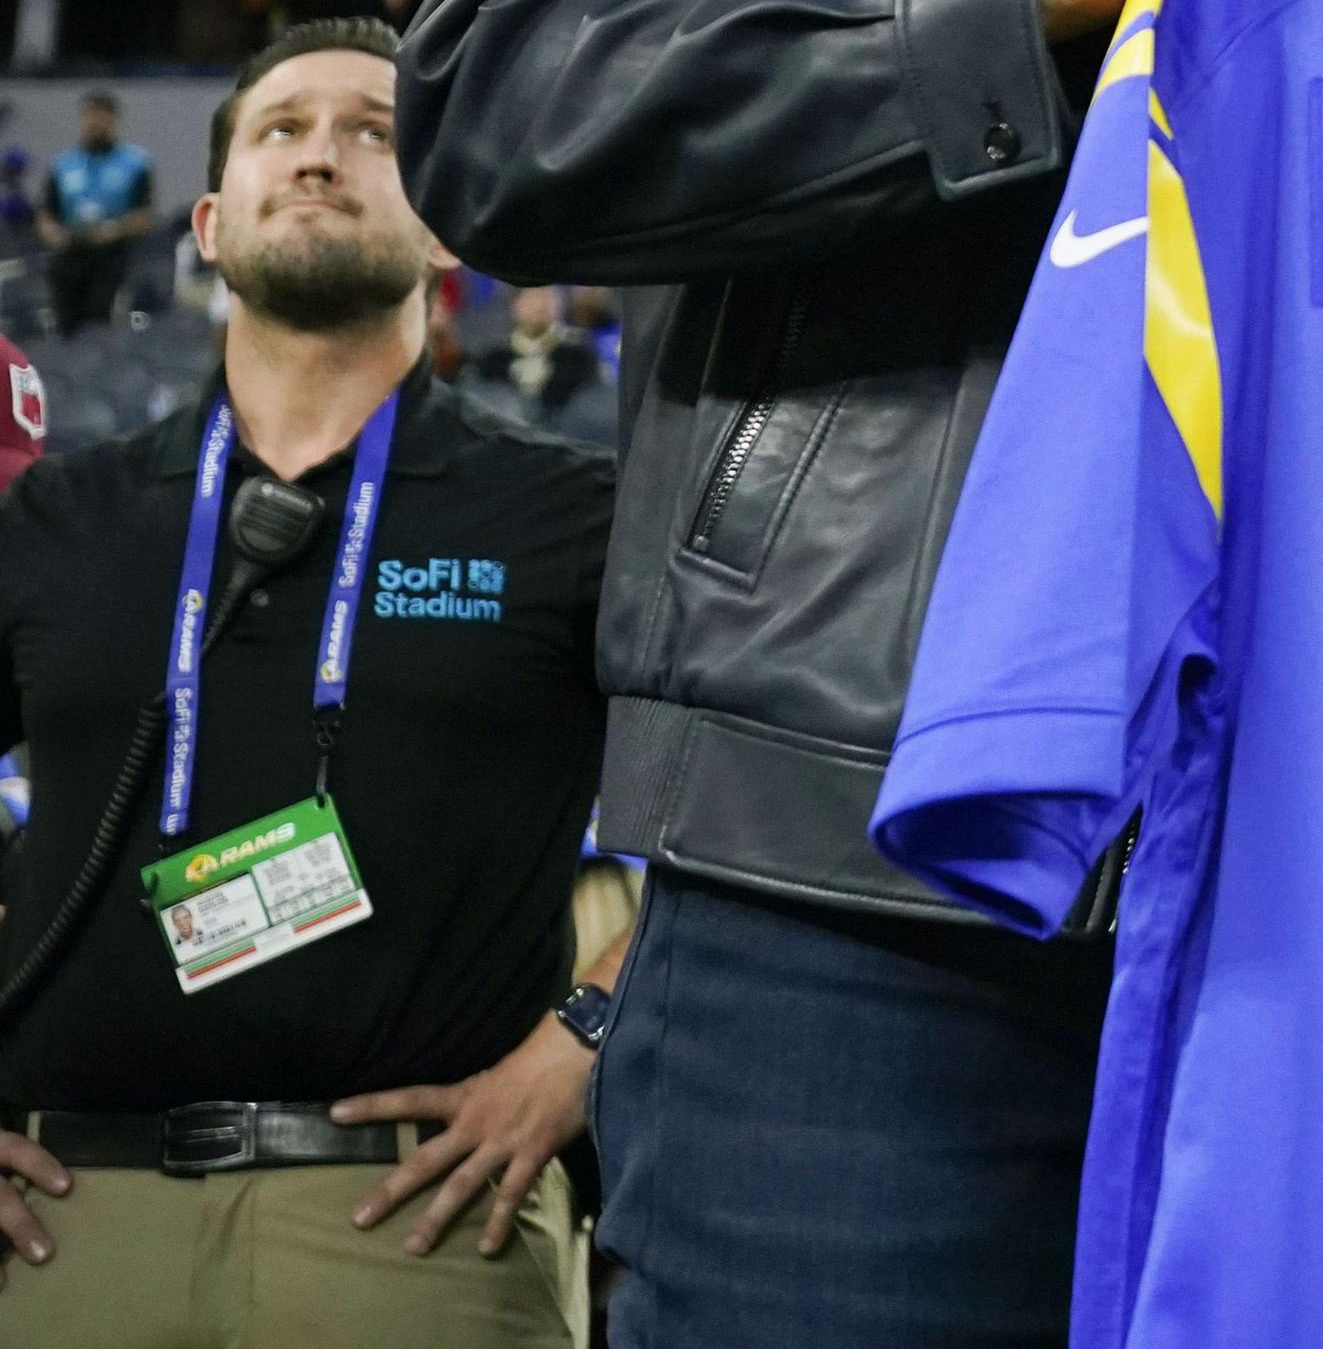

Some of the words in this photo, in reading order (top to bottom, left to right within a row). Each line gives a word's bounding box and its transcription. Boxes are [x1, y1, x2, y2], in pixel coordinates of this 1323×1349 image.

[347, 481, 376, 540] Stadium
[377, 557, 461, 591] SoFi
[374, 591, 501, 621] Stadium
[170, 742, 189, 810] Stadium
[220, 822, 296, 868] RAMS
